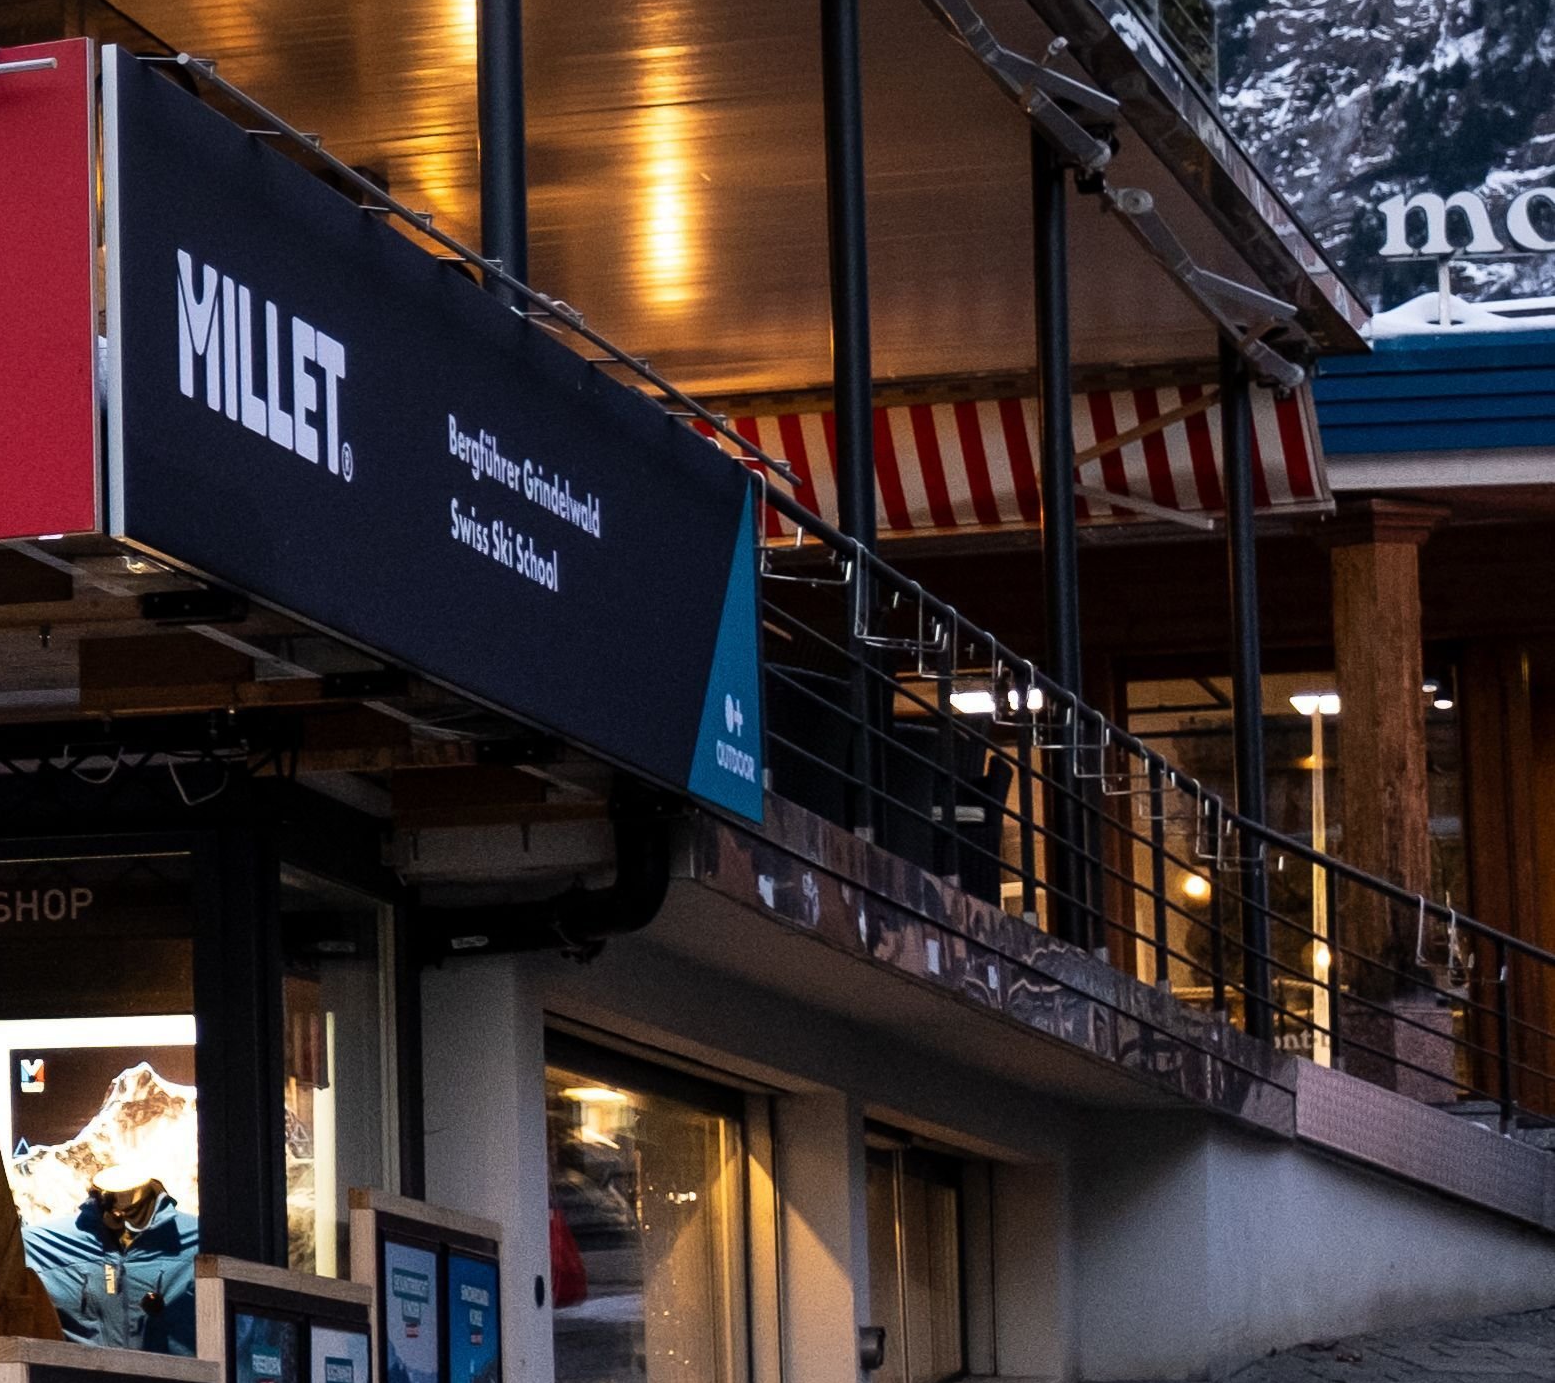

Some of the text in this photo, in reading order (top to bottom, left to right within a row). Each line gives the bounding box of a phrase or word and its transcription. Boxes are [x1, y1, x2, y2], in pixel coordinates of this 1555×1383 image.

[449, 414, 601, 538] Bergführer Grindelwald
[450, 497, 559, 593] Swiss Ski School
[716, 739, 756, 784] OUTDOOR
